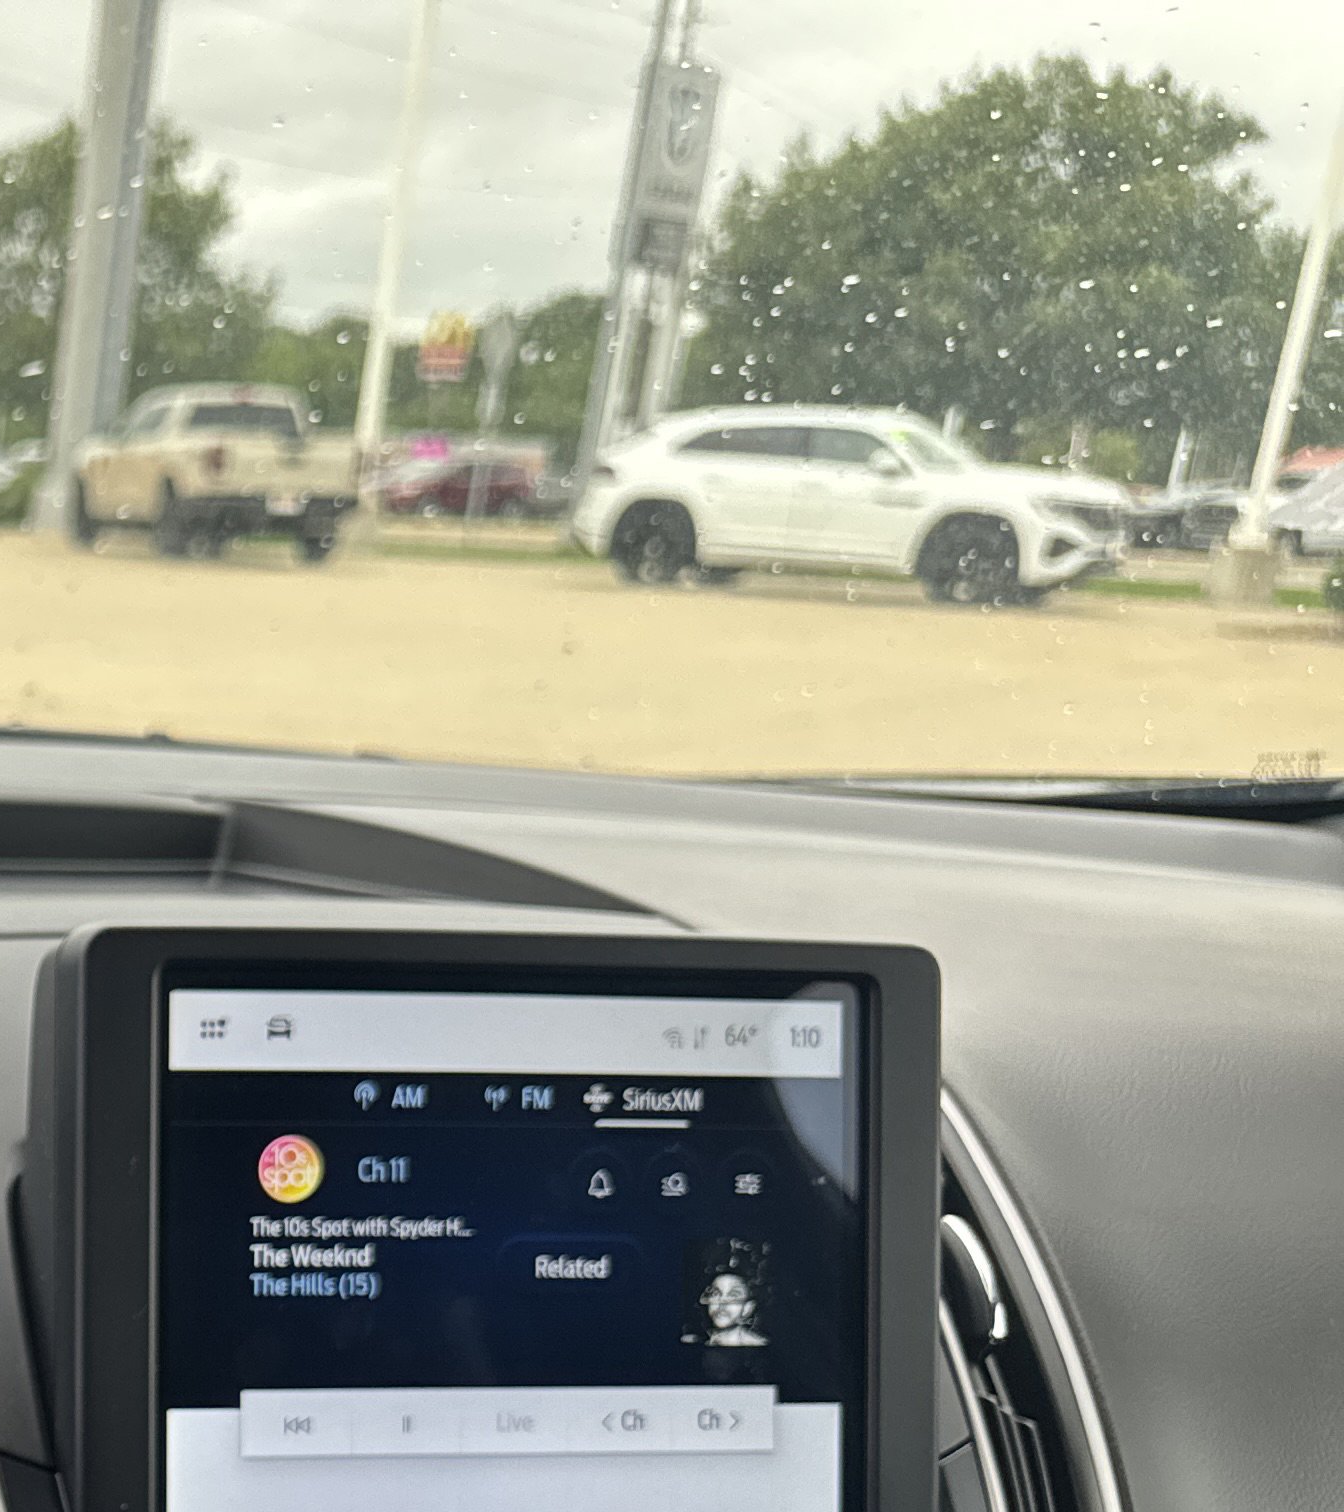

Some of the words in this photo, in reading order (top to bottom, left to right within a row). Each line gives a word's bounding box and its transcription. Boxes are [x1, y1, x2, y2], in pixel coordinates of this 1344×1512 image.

[725, 1024, 758, 1047] 64°
[790, 1025, 822, 1048] 1:10
[391, 1085, 429, 1109] AM
[521, 1086, 555, 1110] FM
[622, 1087, 704, 1112] SiriusXM
[358, 1156, 384, 1183] Ch
[388, 1156, 409, 1183] 11
[249, 1216, 283, 1238] The
[284, 1216, 311, 1238] 10s
[312, 1216, 351, 1240] Spot
[351, 1216, 388, 1238] with
[389, 1216, 444, 1241] Spyder
[249, 1243, 290, 1268] The
[290, 1243, 375, 1268] Weeknd
[535, 1254, 612, 1280] Related
[249, 1273, 290, 1297] The
[290, 1273, 337, 1297] Hills
[338, 1273, 381, 1300] (15)
[496, 1412, 535, 1433] Live
[620, 1409, 646, 1431] Ch
[697, 1408, 721, 1430] Ch
